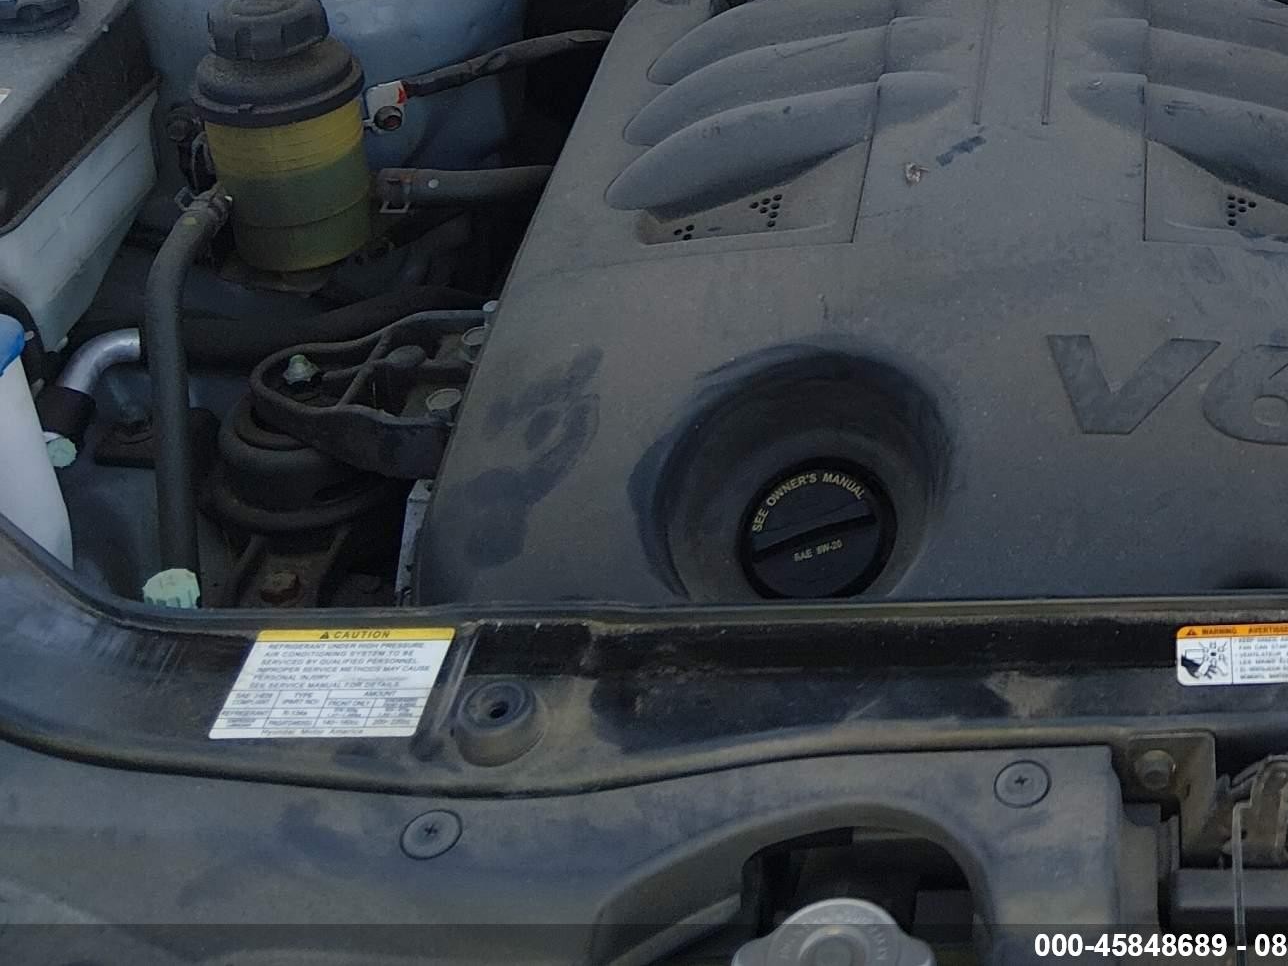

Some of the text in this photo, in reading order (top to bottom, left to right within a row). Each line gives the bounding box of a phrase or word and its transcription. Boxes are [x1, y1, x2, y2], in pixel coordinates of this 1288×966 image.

[752, 472, 865, 532] SEE OWNER'S MANUAL
[334, 631, 391, 639] CAUTION
